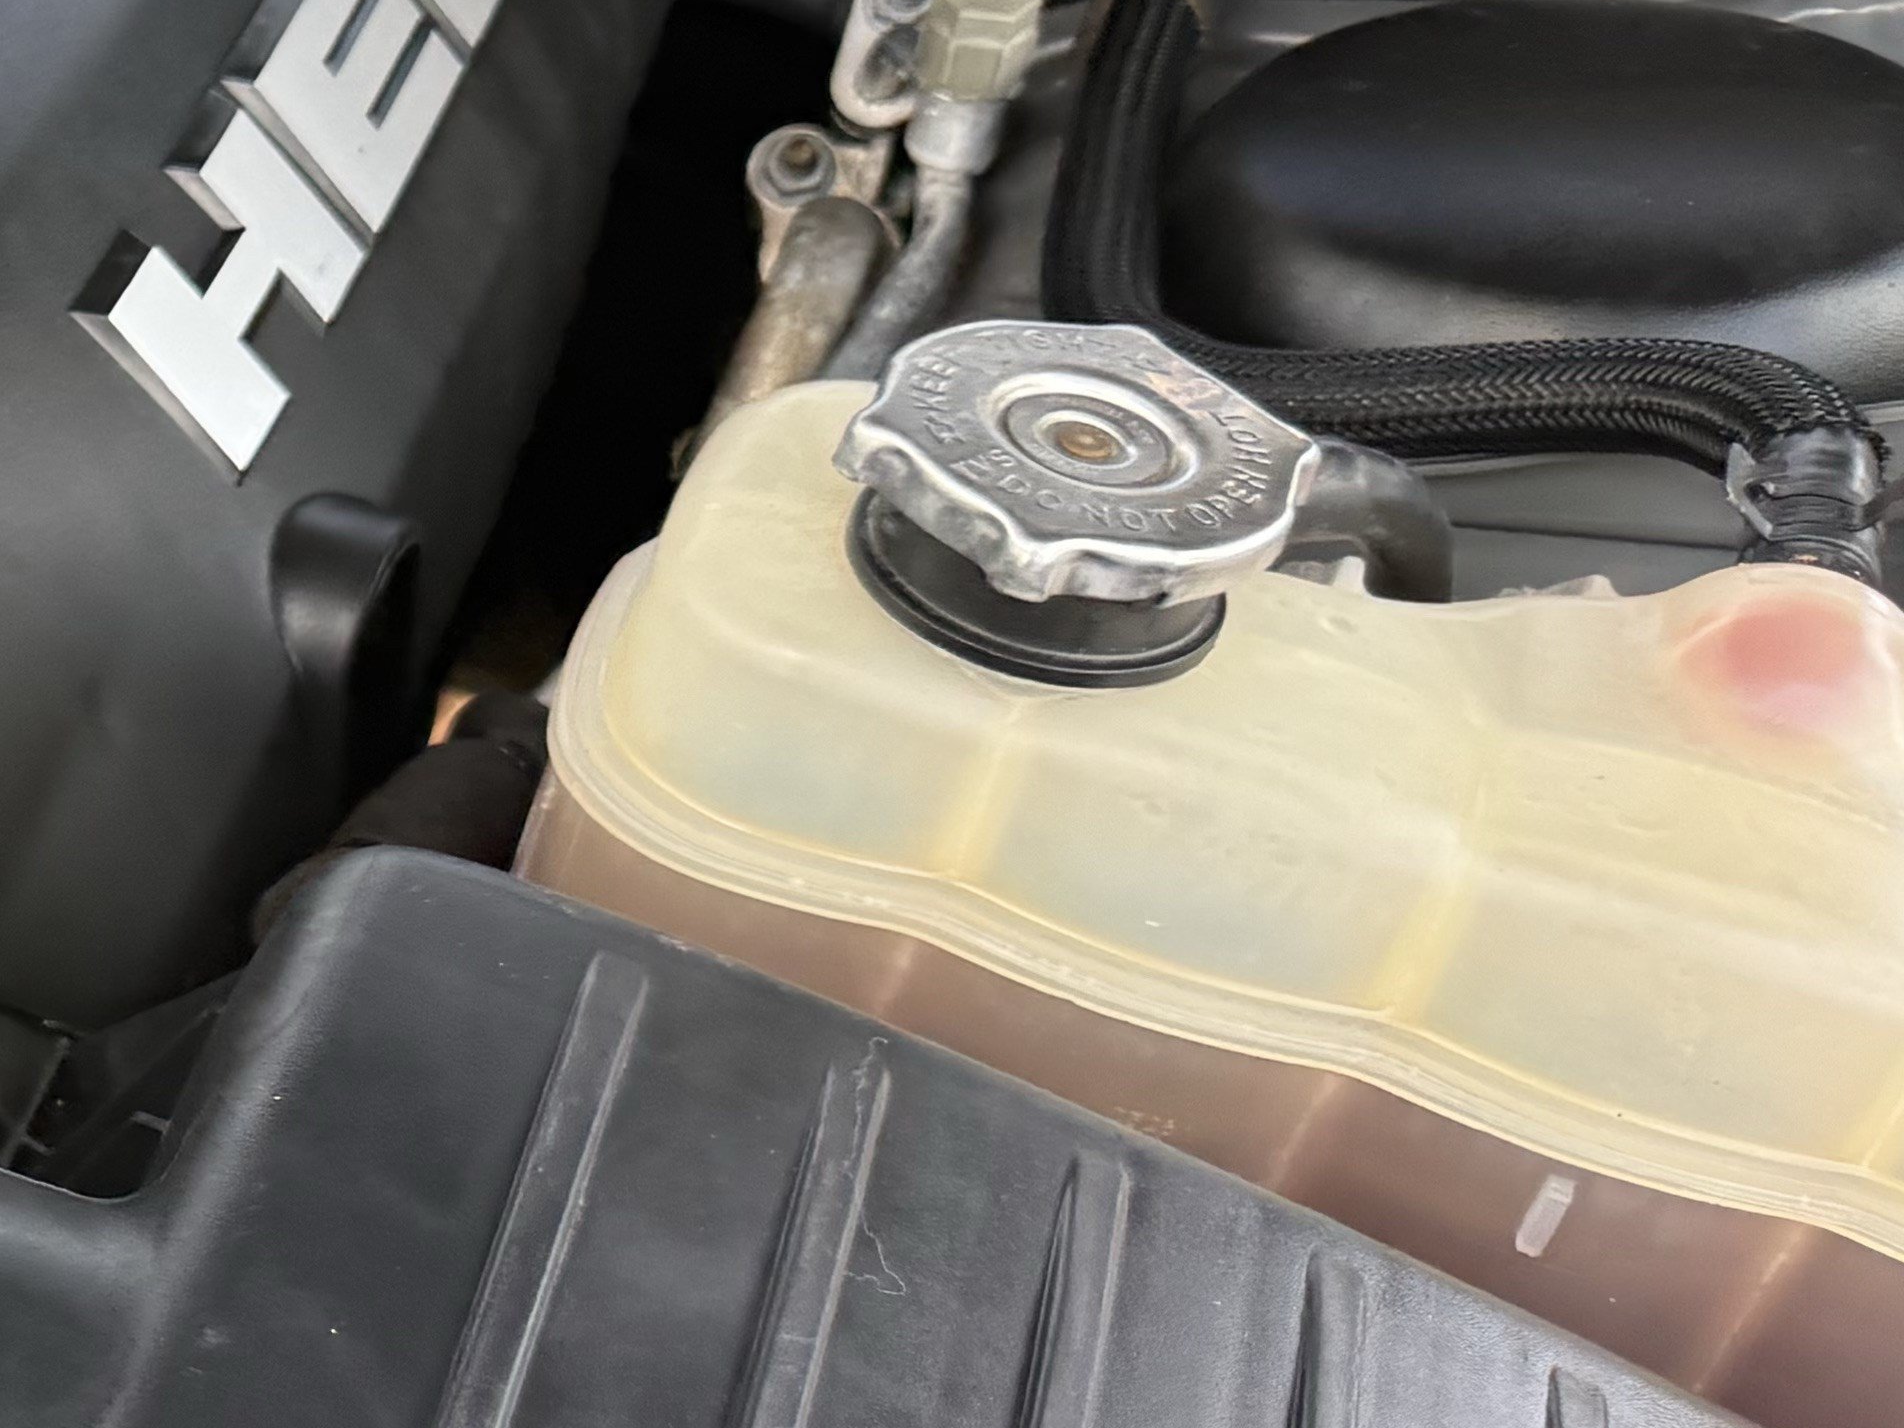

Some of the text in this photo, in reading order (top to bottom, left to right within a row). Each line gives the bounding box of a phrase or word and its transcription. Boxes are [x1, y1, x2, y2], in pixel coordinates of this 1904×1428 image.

[1208, 412, 1276, 465] HOT
[995, 472, 1064, 511] DO
[1186, 464, 1274, 529] OPEN
[1080, 502, 1180, 534] NOT
